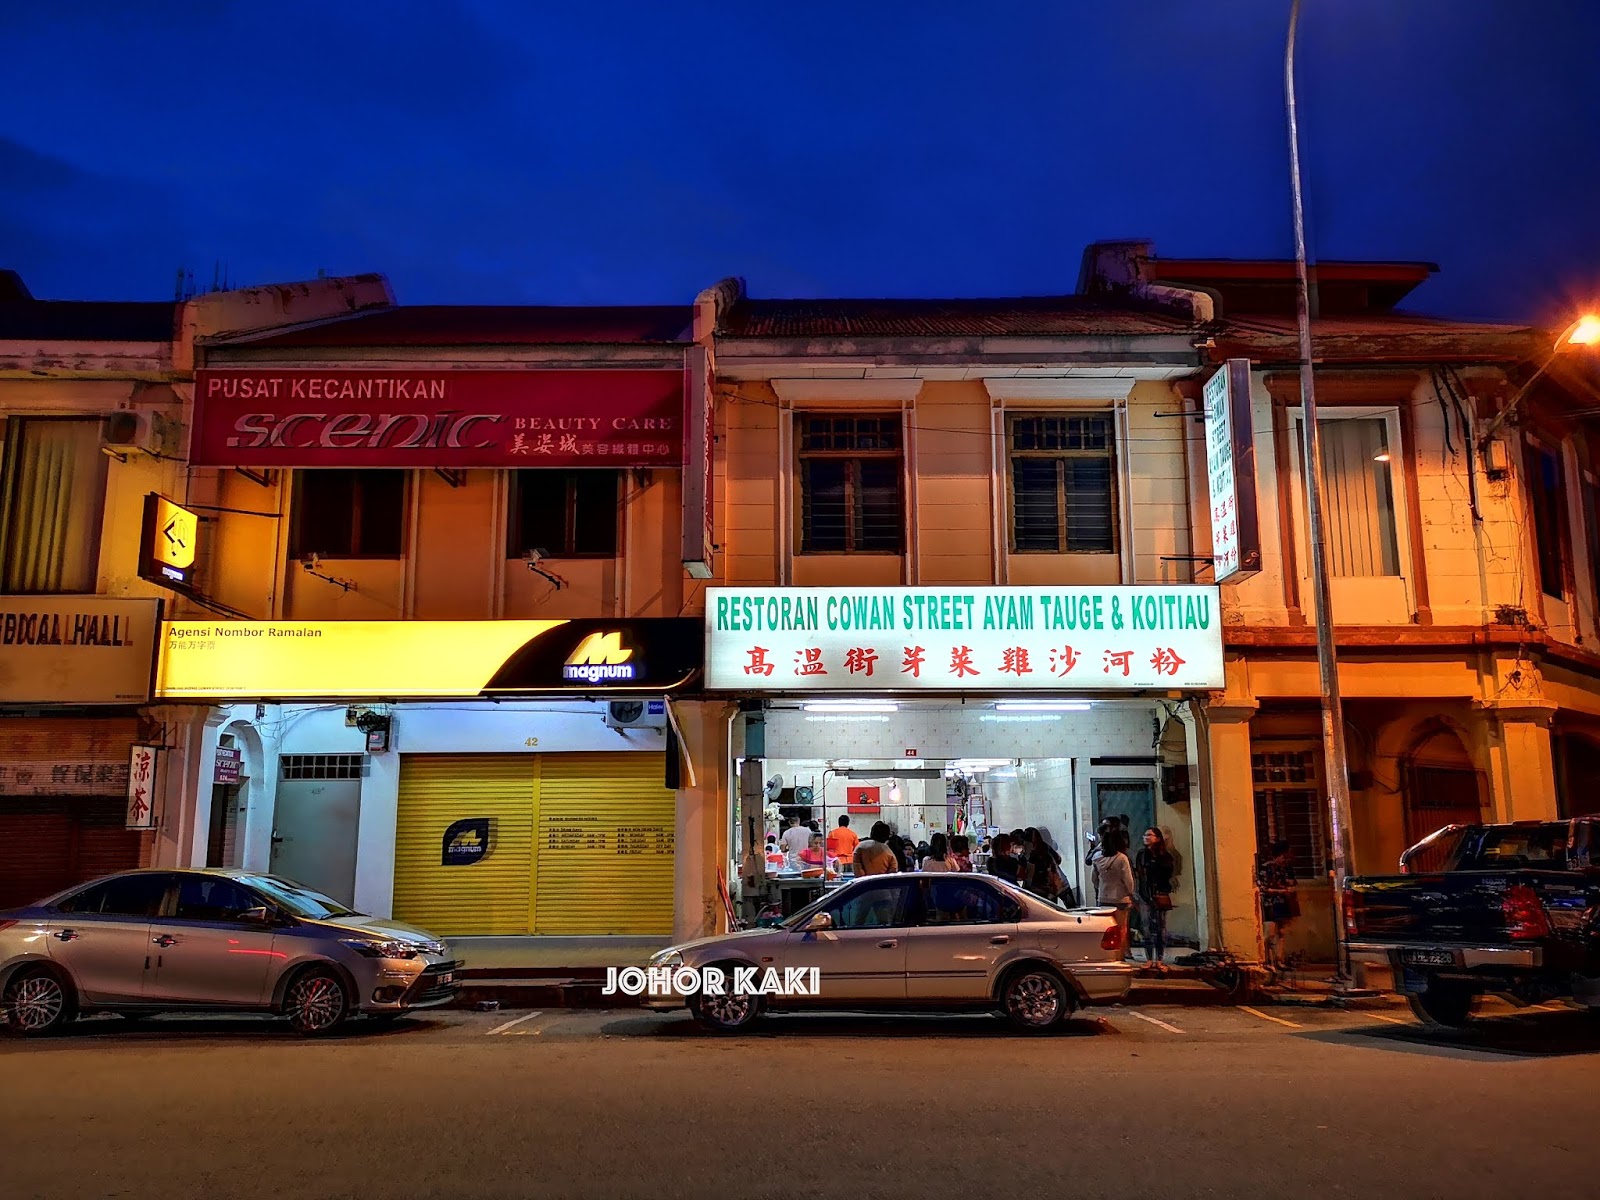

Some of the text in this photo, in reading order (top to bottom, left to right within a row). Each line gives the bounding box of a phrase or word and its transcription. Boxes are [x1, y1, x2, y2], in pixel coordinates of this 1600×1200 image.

[208, 378, 446, 399] PUSAT KECANTIKAN
[227, 412, 504, 448] scenic
[515, 417, 671, 430] BEAUTY CARE
[718, 595, 1210, 631] RESTORAN COWAN STREET AYAM TAUGE & KOITIAU
[169, 627, 322, 638] Agensi Nombor Ramalan
[563, 665, 632, 682] magnum
[525, 737, 538, 746] 42
